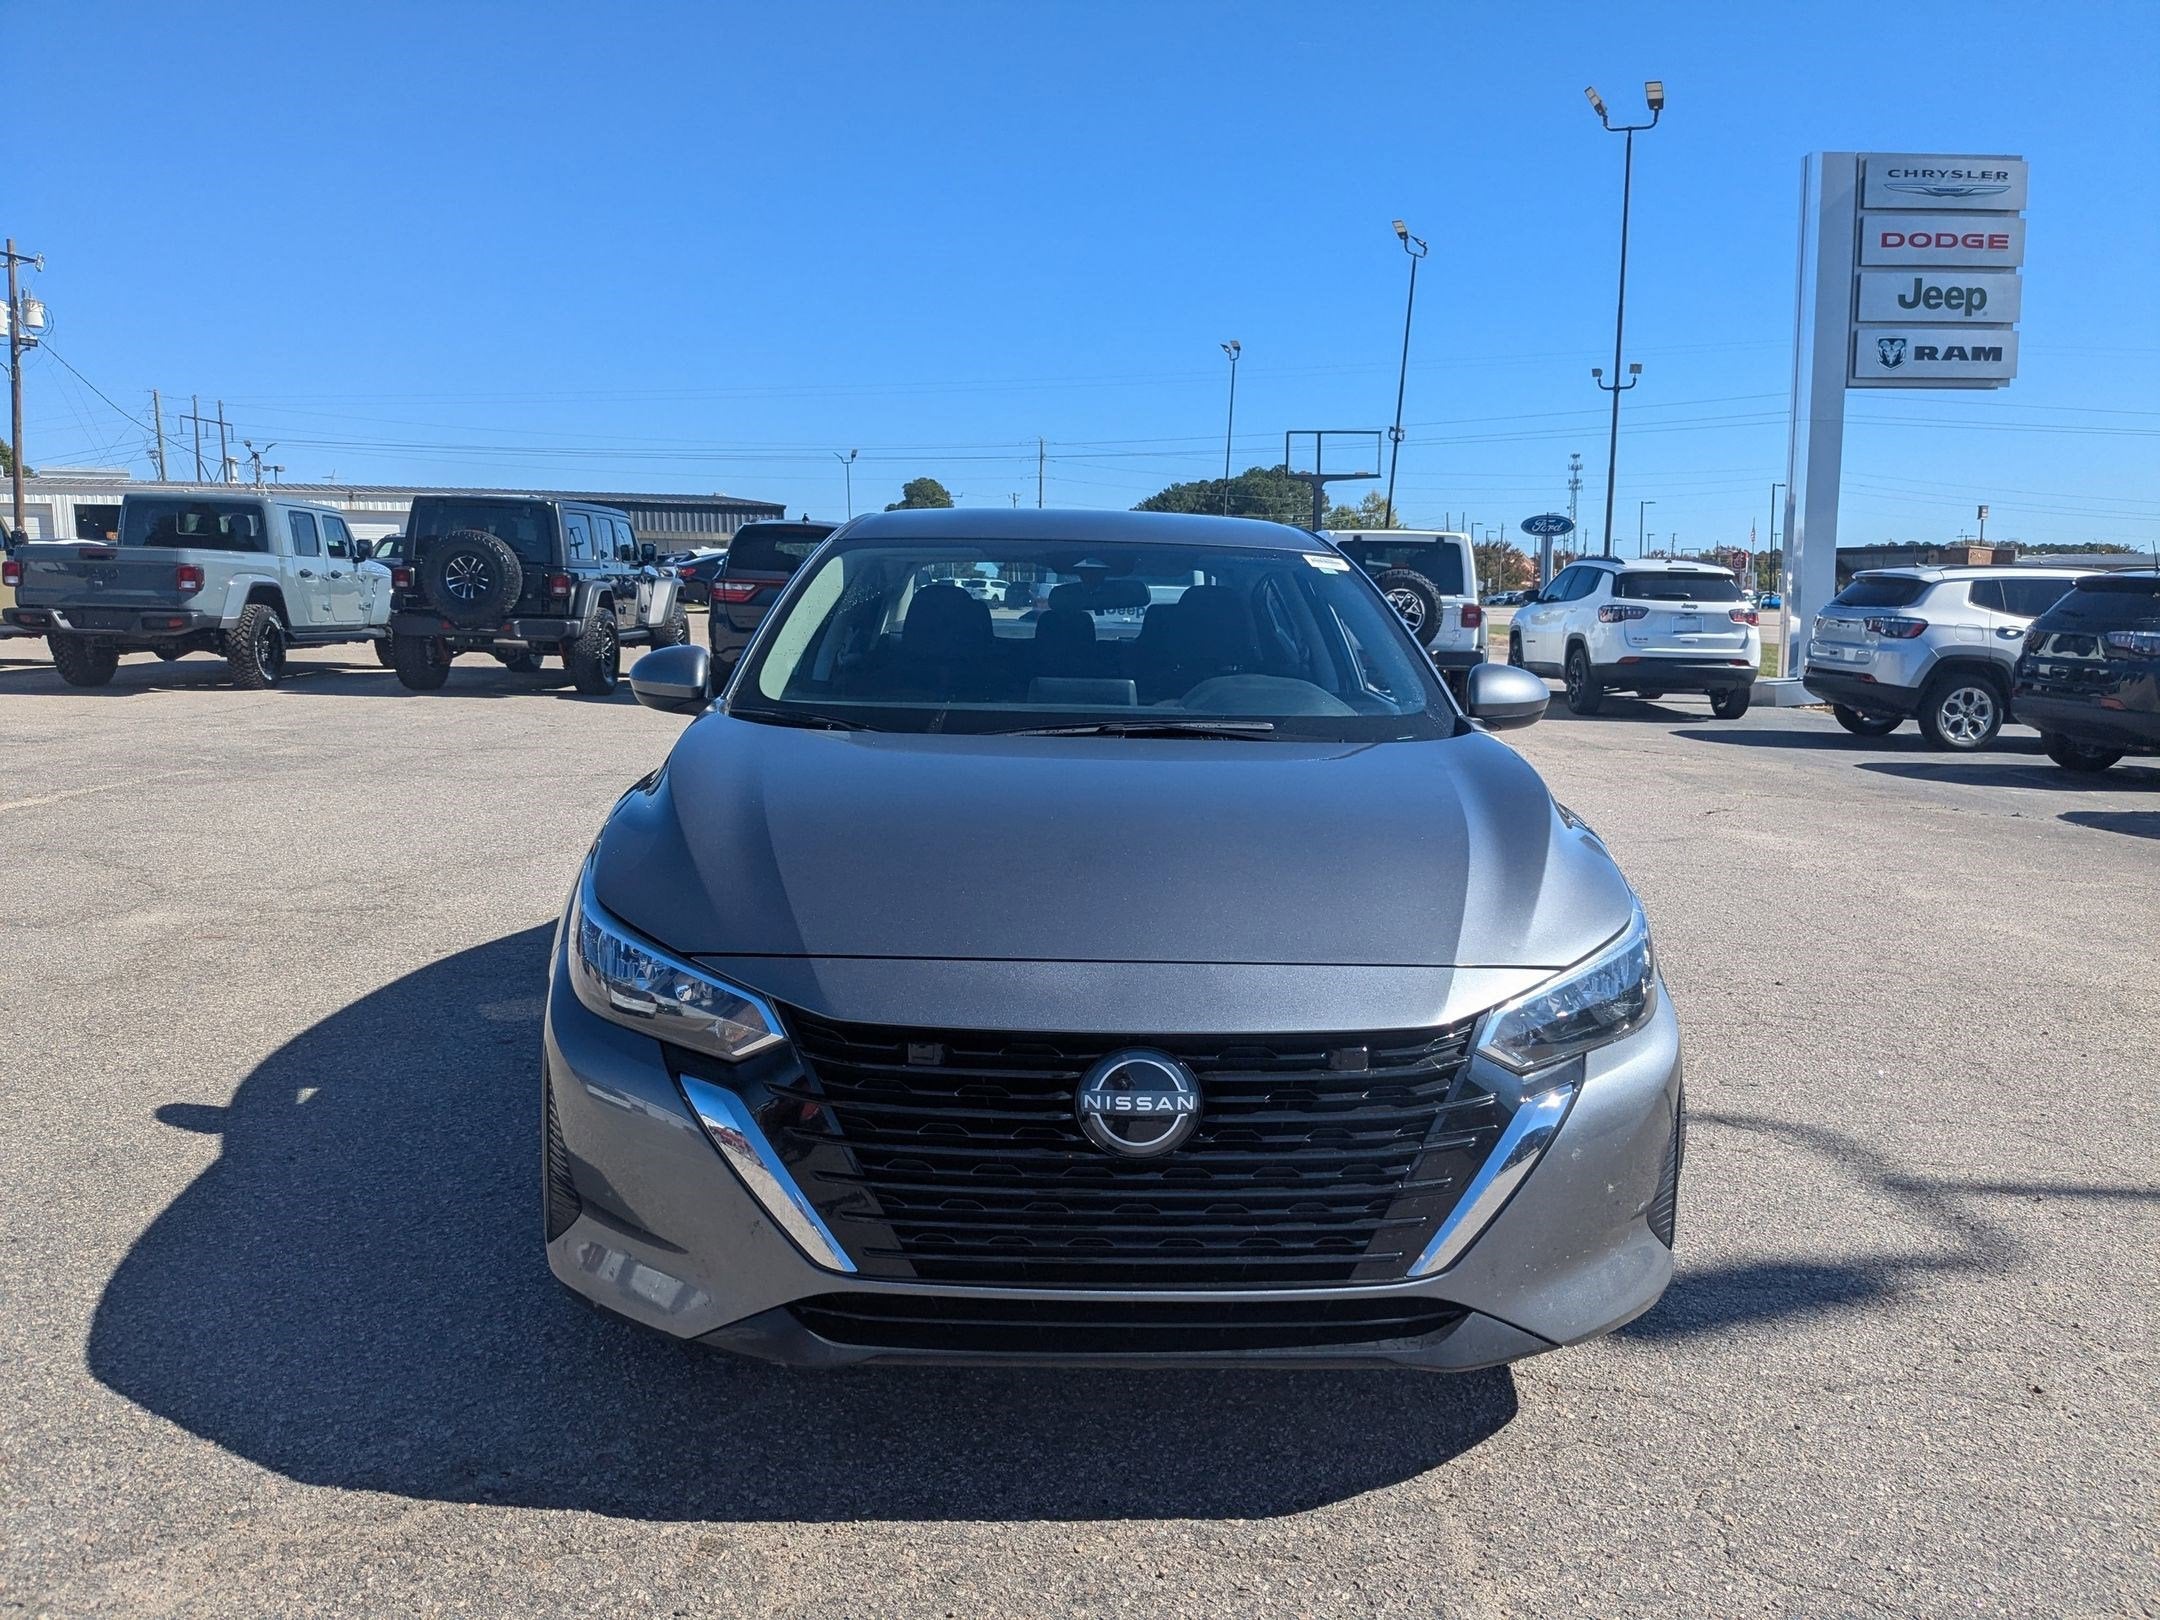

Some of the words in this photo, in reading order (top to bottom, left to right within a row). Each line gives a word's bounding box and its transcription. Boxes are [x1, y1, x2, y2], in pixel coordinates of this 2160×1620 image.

[1887, 169, 2009, 180] CHRYSLER
[1880, 232, 2010, 249] DODGE
[1897, 277, 1988, 317] Jeep
[1913, 345, 2003, 362] RAM
[1531, 518, 1564, 533] Ford
[1084, 1094, 1194, 1111] NISSAN
